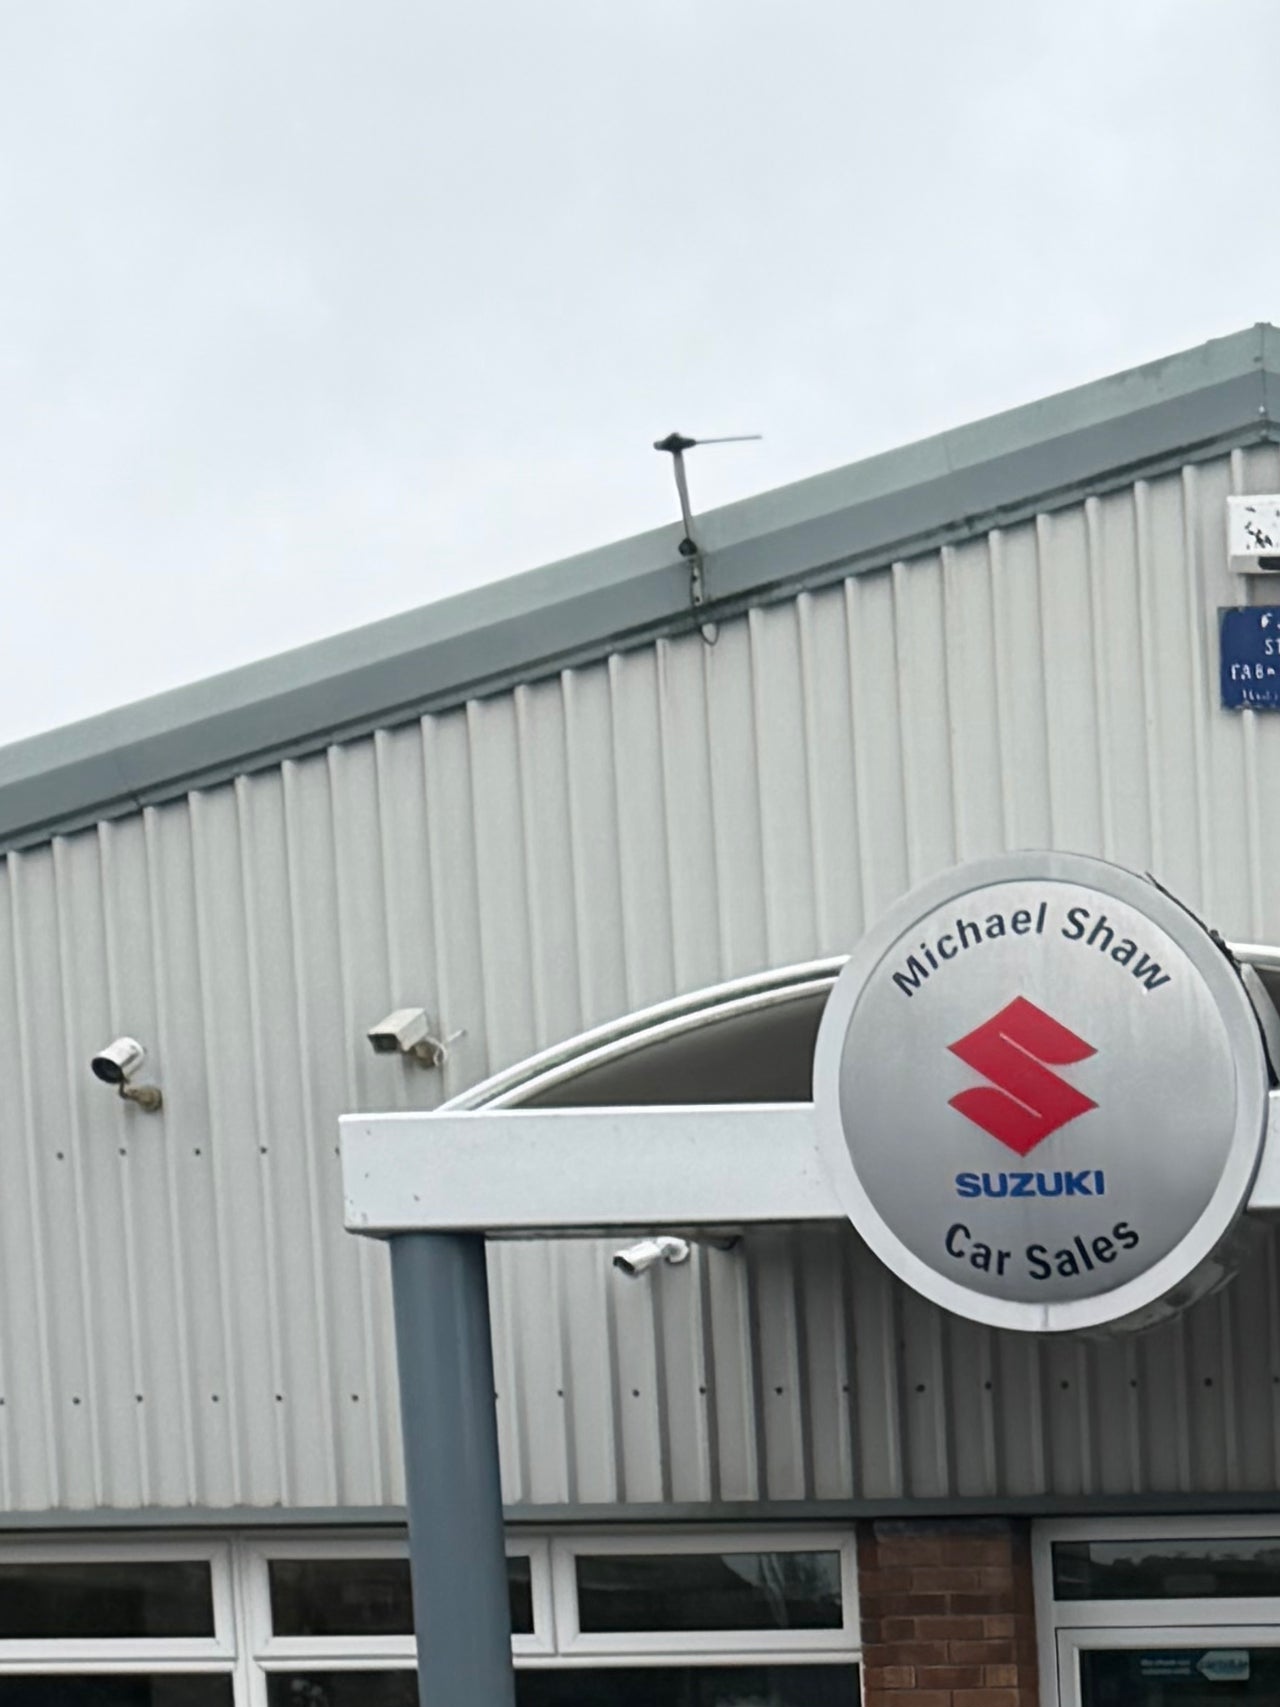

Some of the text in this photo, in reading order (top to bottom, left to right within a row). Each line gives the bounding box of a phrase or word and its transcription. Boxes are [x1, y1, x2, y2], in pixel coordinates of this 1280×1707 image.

[892, 901, 1171, 998] Michael Shaw
[954, 1169, 1106, 1199] SUZUKI
[944, 1220, 1140, 1281] Car Sales
